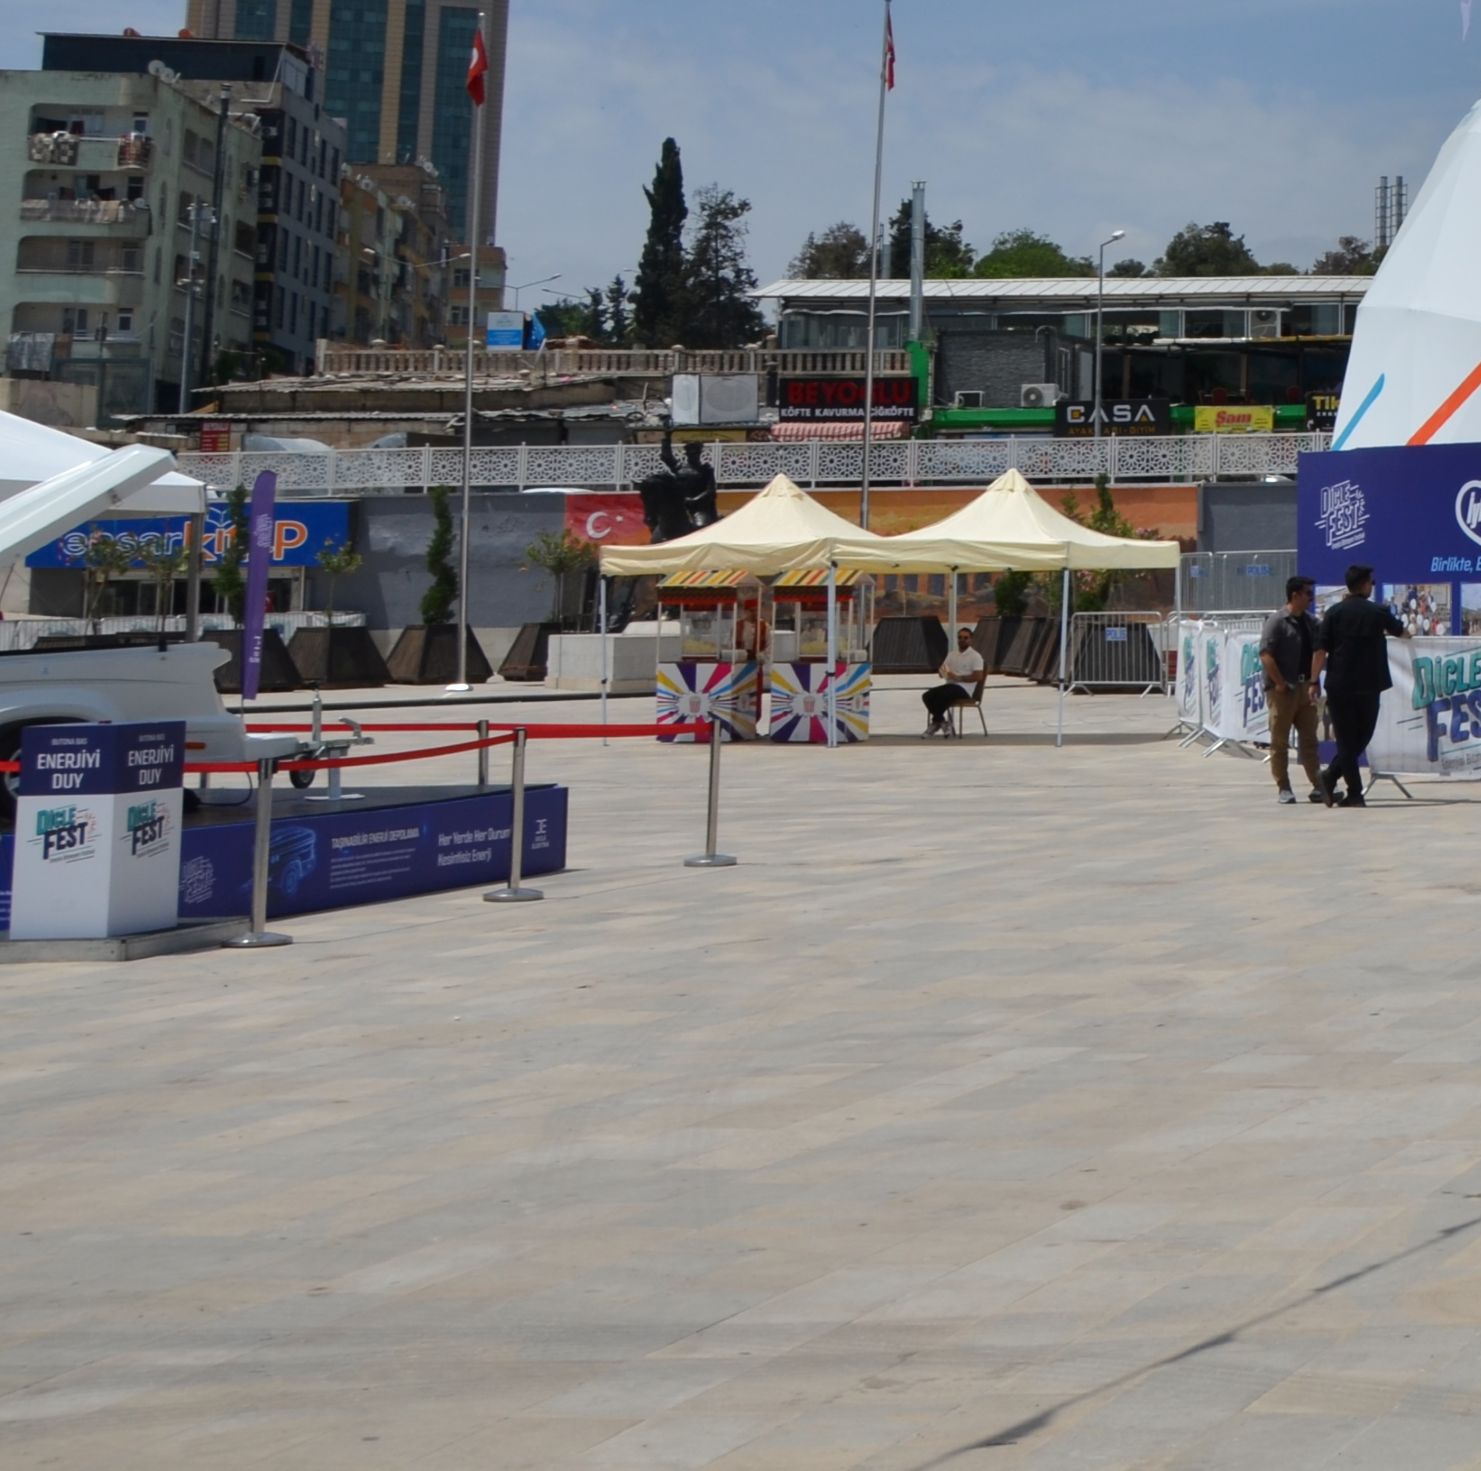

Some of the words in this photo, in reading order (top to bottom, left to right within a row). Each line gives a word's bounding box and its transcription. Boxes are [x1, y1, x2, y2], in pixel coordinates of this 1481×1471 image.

[781, 406, 811, 417] KÖFTE
[815, 407, 865, 417] KAVURMA
[1067, 404, 1156, 423] CASA
[1430, 556, 1473, 574] Birlikte,
[37, 749, 101, 770] ENERJİYİ
[52, 773, 84, 790] DUY
[139, 768, 162, 786] DUY
[43, 822, 88, 860] FEST
[132, 815, 165, 856] FEST
